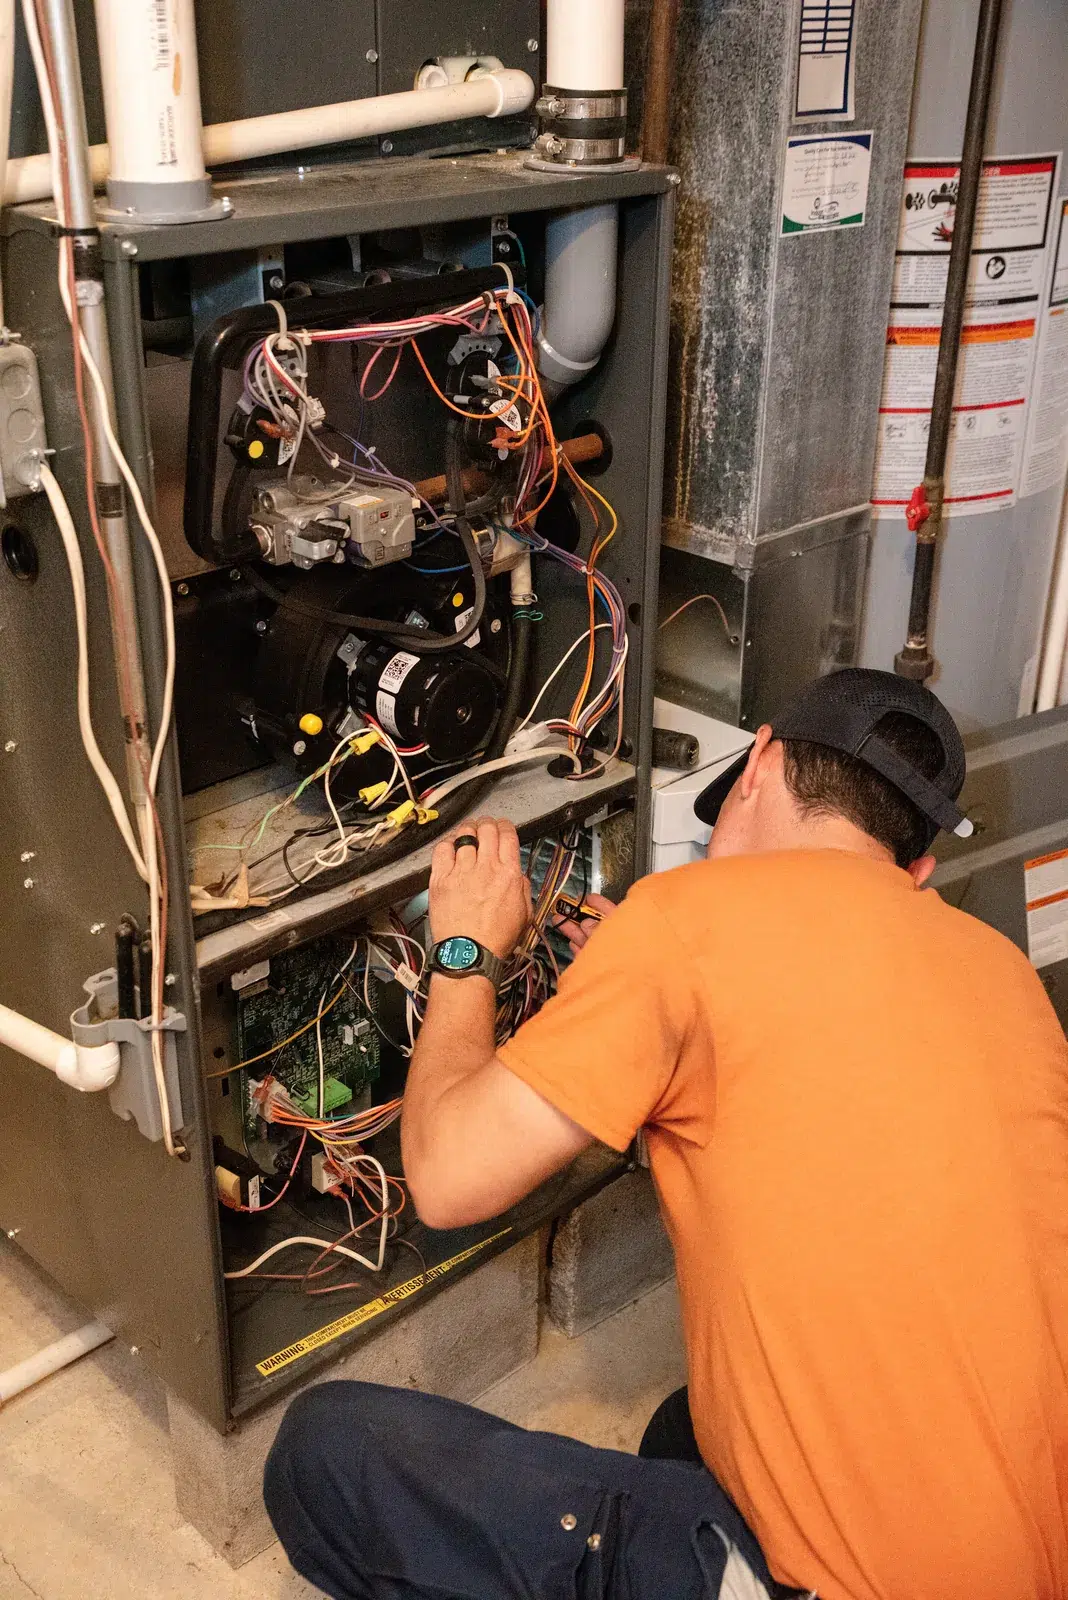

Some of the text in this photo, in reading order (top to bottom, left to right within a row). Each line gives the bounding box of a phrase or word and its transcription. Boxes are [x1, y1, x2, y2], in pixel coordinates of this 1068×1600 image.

[305, 1335, 316, 1344] THIS
[315, 1317, 347, 1338] COMPARTMENT
[308, 1306, 379, 1347] CLOSED EXCEPT WHEN SERVICING
[260, 1343, 308, 1371] WARNING:
